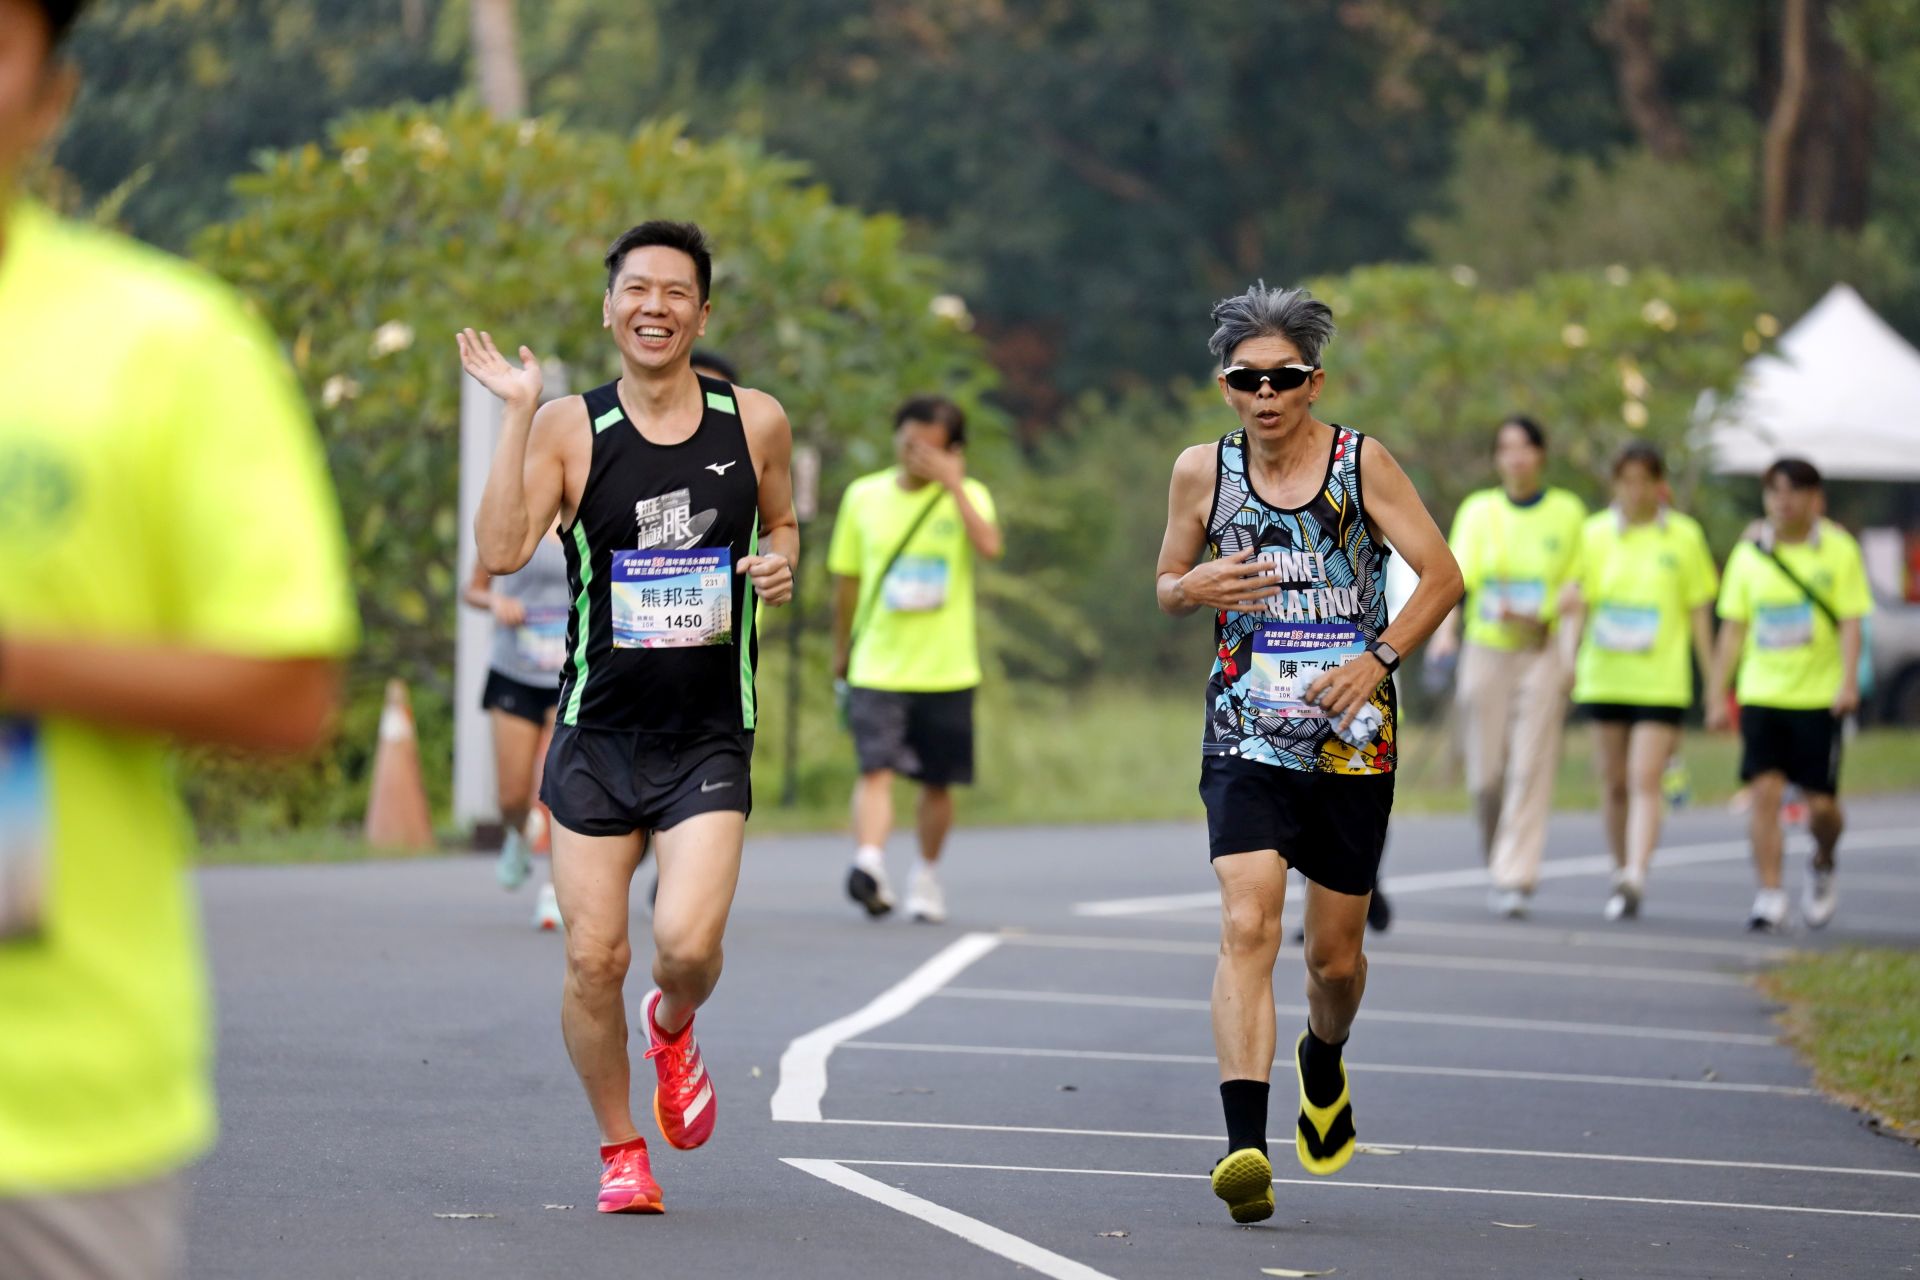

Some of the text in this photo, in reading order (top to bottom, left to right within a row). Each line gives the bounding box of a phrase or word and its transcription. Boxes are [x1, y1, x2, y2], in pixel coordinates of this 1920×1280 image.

[704, 579, 718, 587] 231
[641, 587, 704, 608] 熊邦志
[665, 614, 702, 628] 1450
